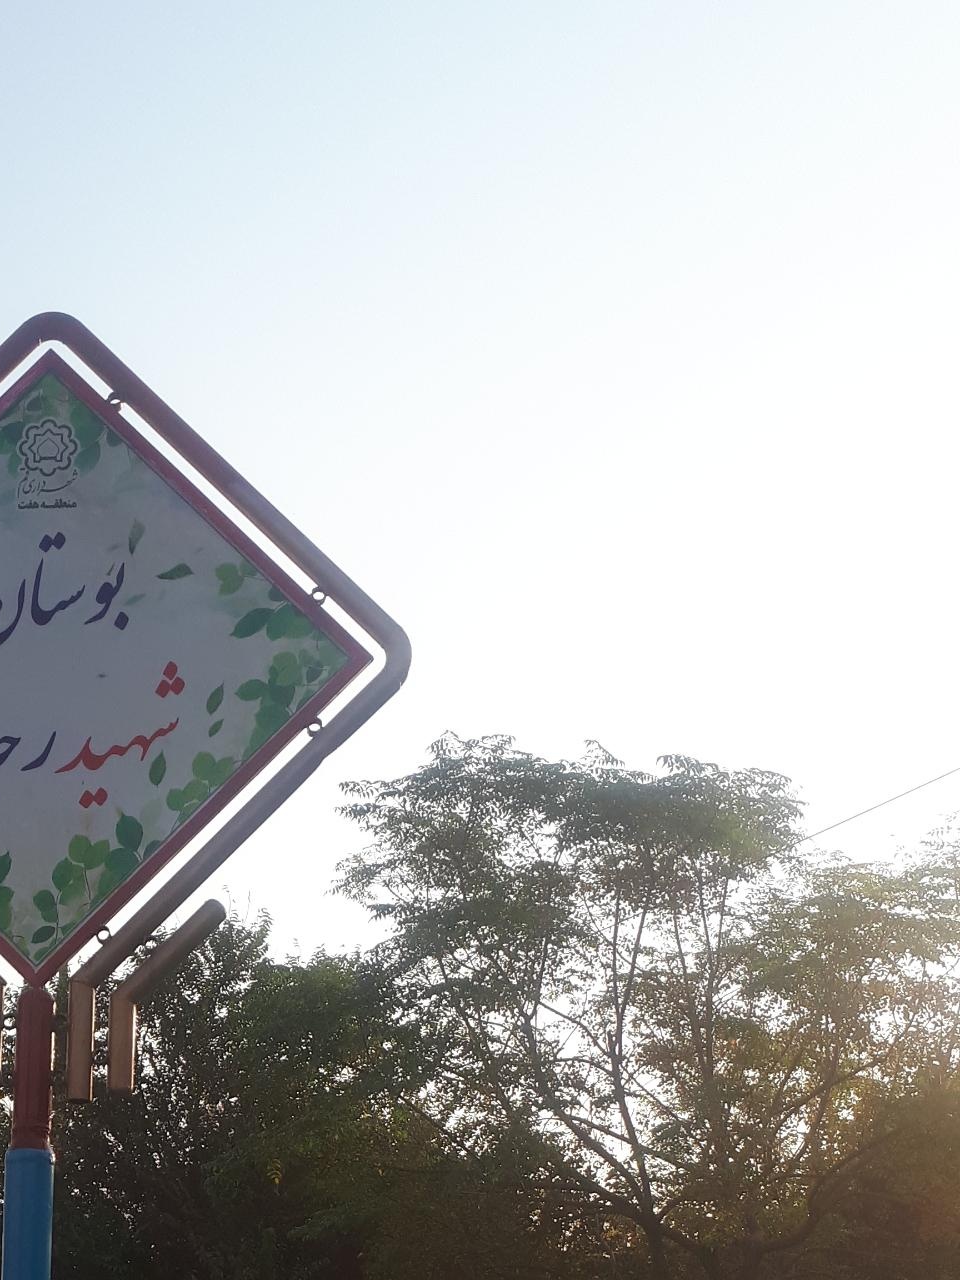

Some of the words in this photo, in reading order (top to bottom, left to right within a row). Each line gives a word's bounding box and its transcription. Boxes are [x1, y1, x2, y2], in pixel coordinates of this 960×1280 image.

[17, 500, 39, 510] هفت
[40, 498, 78, 509] منطقه
[54, 660, 186, 809] شهید
